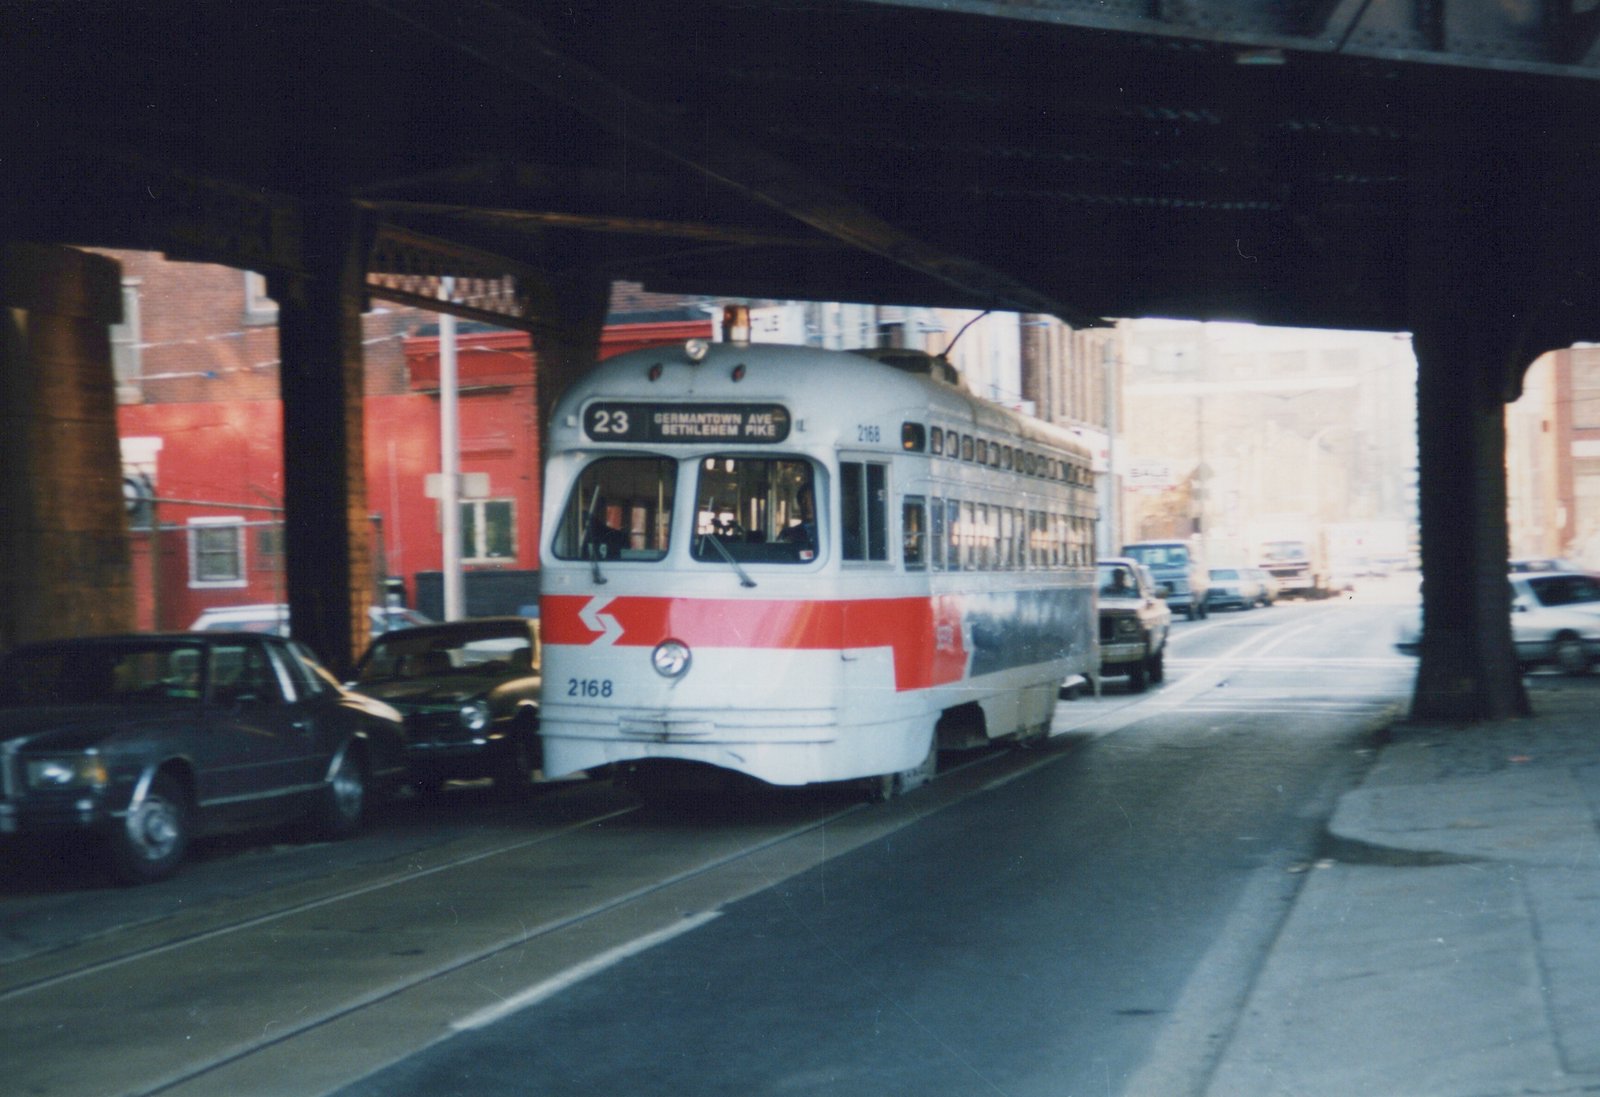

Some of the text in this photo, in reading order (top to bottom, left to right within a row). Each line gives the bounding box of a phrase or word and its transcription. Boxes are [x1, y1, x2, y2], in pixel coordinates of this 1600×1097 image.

[593, 410, 629, 433] 23
[654, 412, 742, 424] GERMANTOWN
[661, 424, 776, 436] BETHLEHEM PIKE
[858, 423, 880, 442] 2168
[567, 678, 613, 697] 2168
